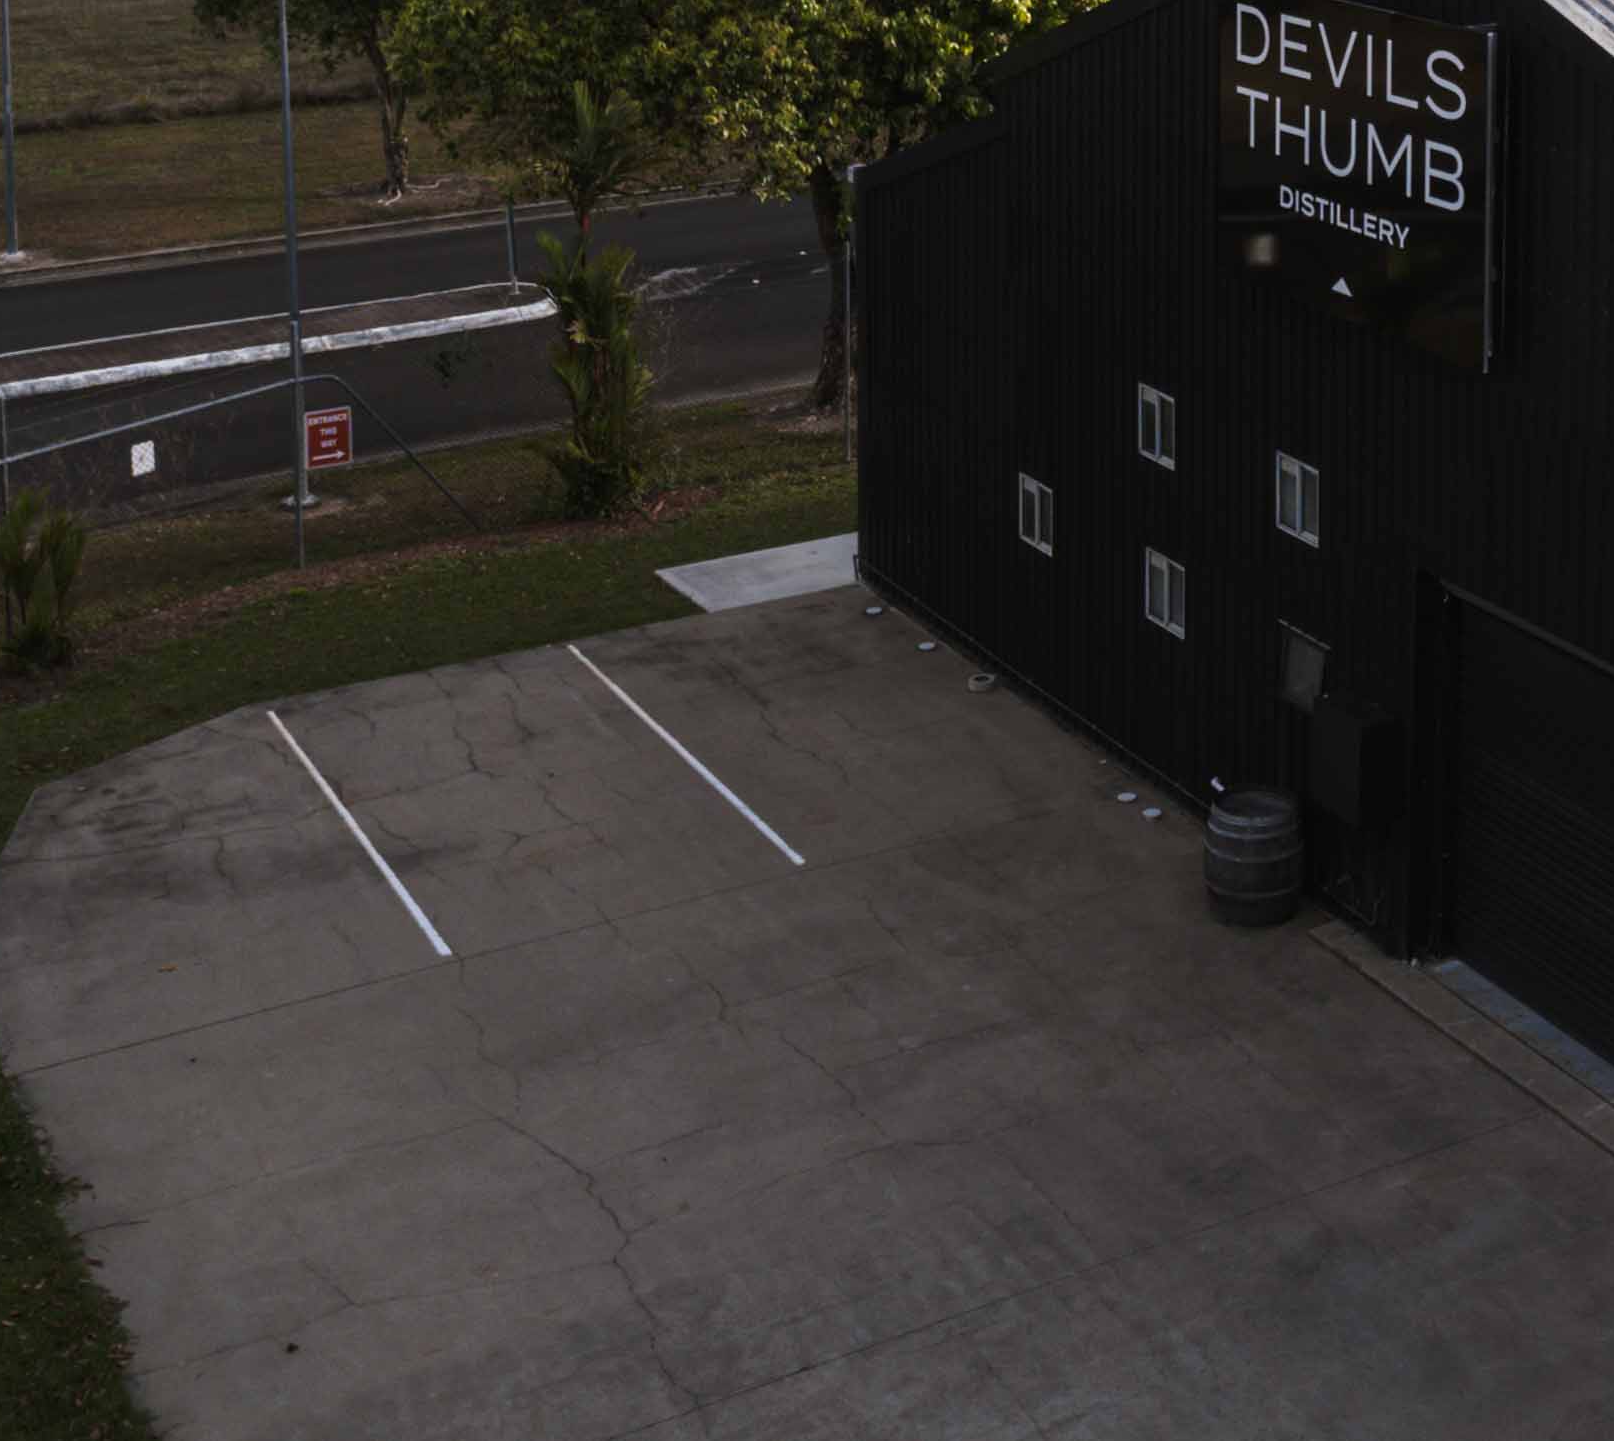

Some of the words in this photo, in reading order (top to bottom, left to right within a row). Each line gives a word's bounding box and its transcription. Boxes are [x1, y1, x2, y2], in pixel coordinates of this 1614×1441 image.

[1236, 2, 1467, 120] DEVILS
[1236, 85, 1465, 212] THUMB
[1279, 184, 1410, 249] DISTILLERY
